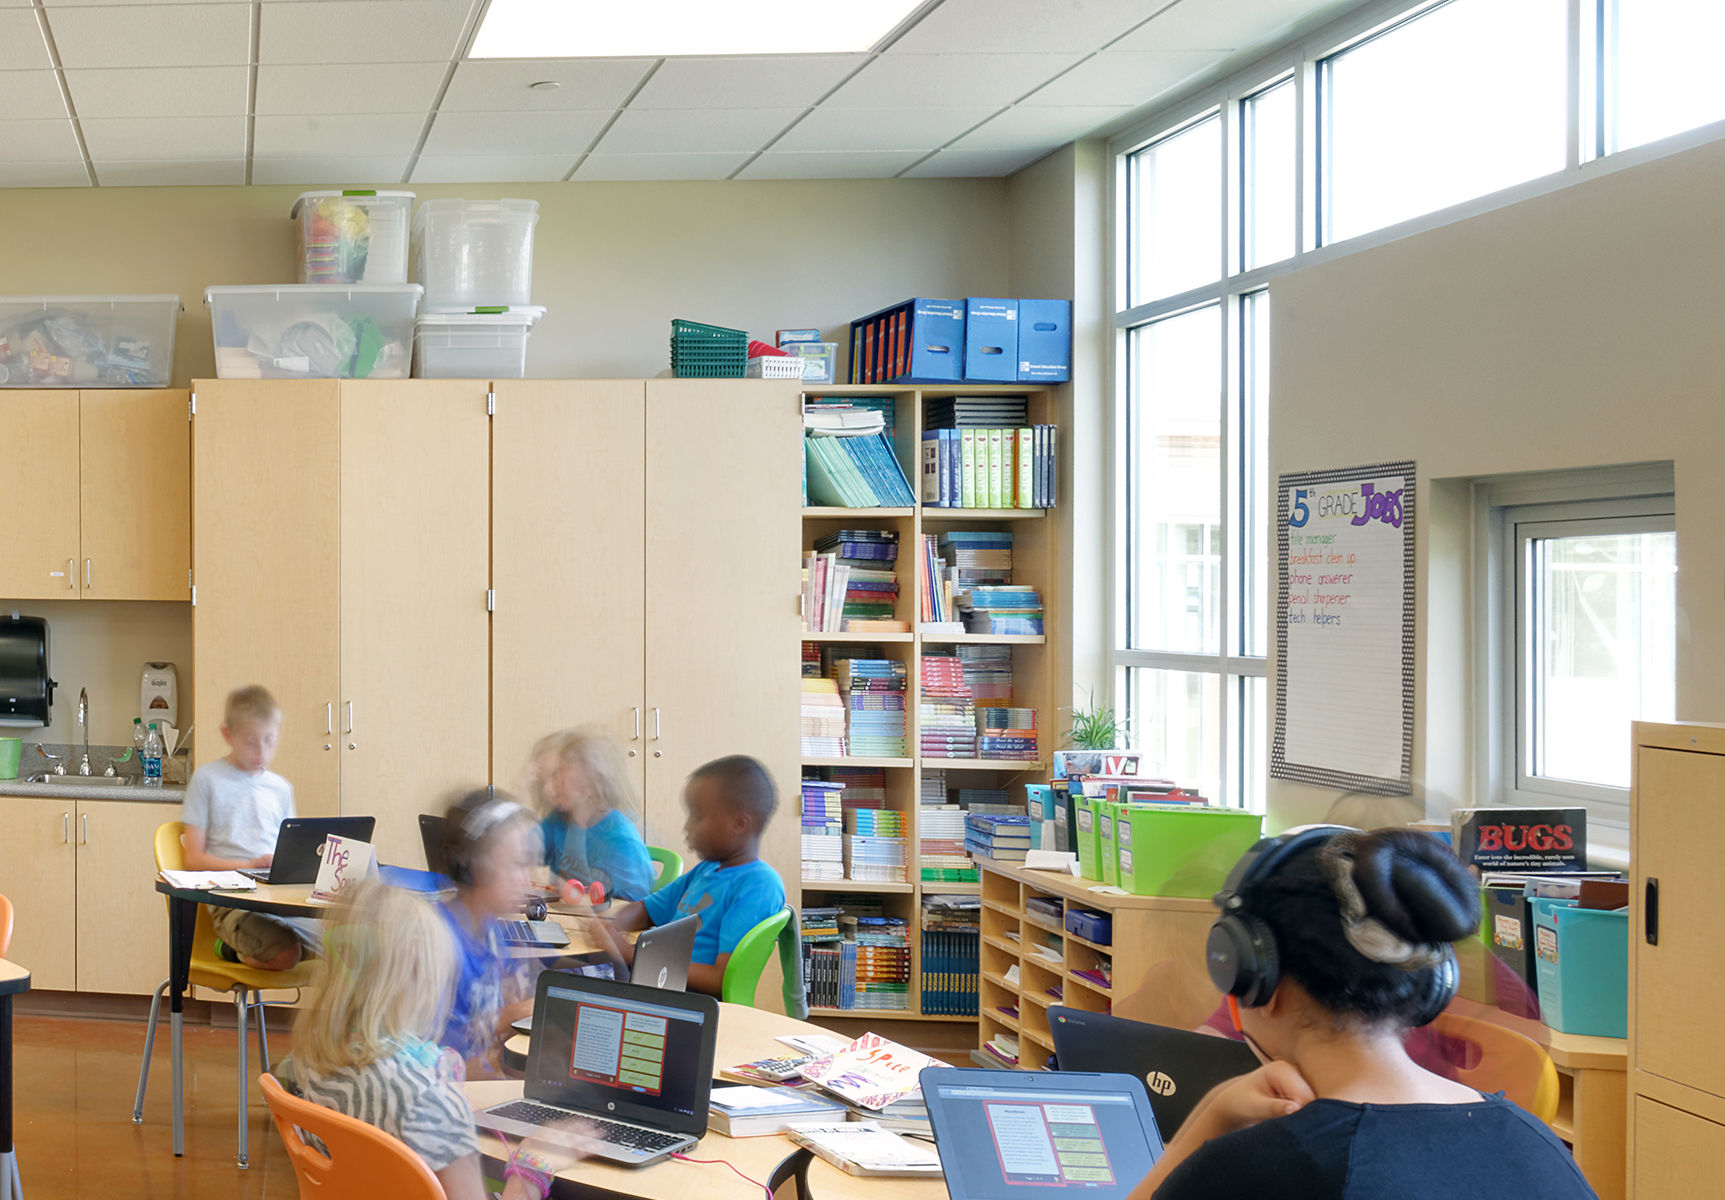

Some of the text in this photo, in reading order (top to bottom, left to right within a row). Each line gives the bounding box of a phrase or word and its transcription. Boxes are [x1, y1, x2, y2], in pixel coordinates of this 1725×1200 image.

[1318, 492, 1358, 517] GRADE
[1306, 533, 1337, 548] manager
[1289, 548, 1356, 567] breakfast clean up
[1289, 570, 1312, 589] phone
[1288, 589, 1351, 607] pencil sharpener
[1288, 607, 1341, 628] tech helpers
[1478, 825, 1574, 851] BUGS
[327, 836, 349, 867] The
[1149, 1071, 1173, 1096] hp
